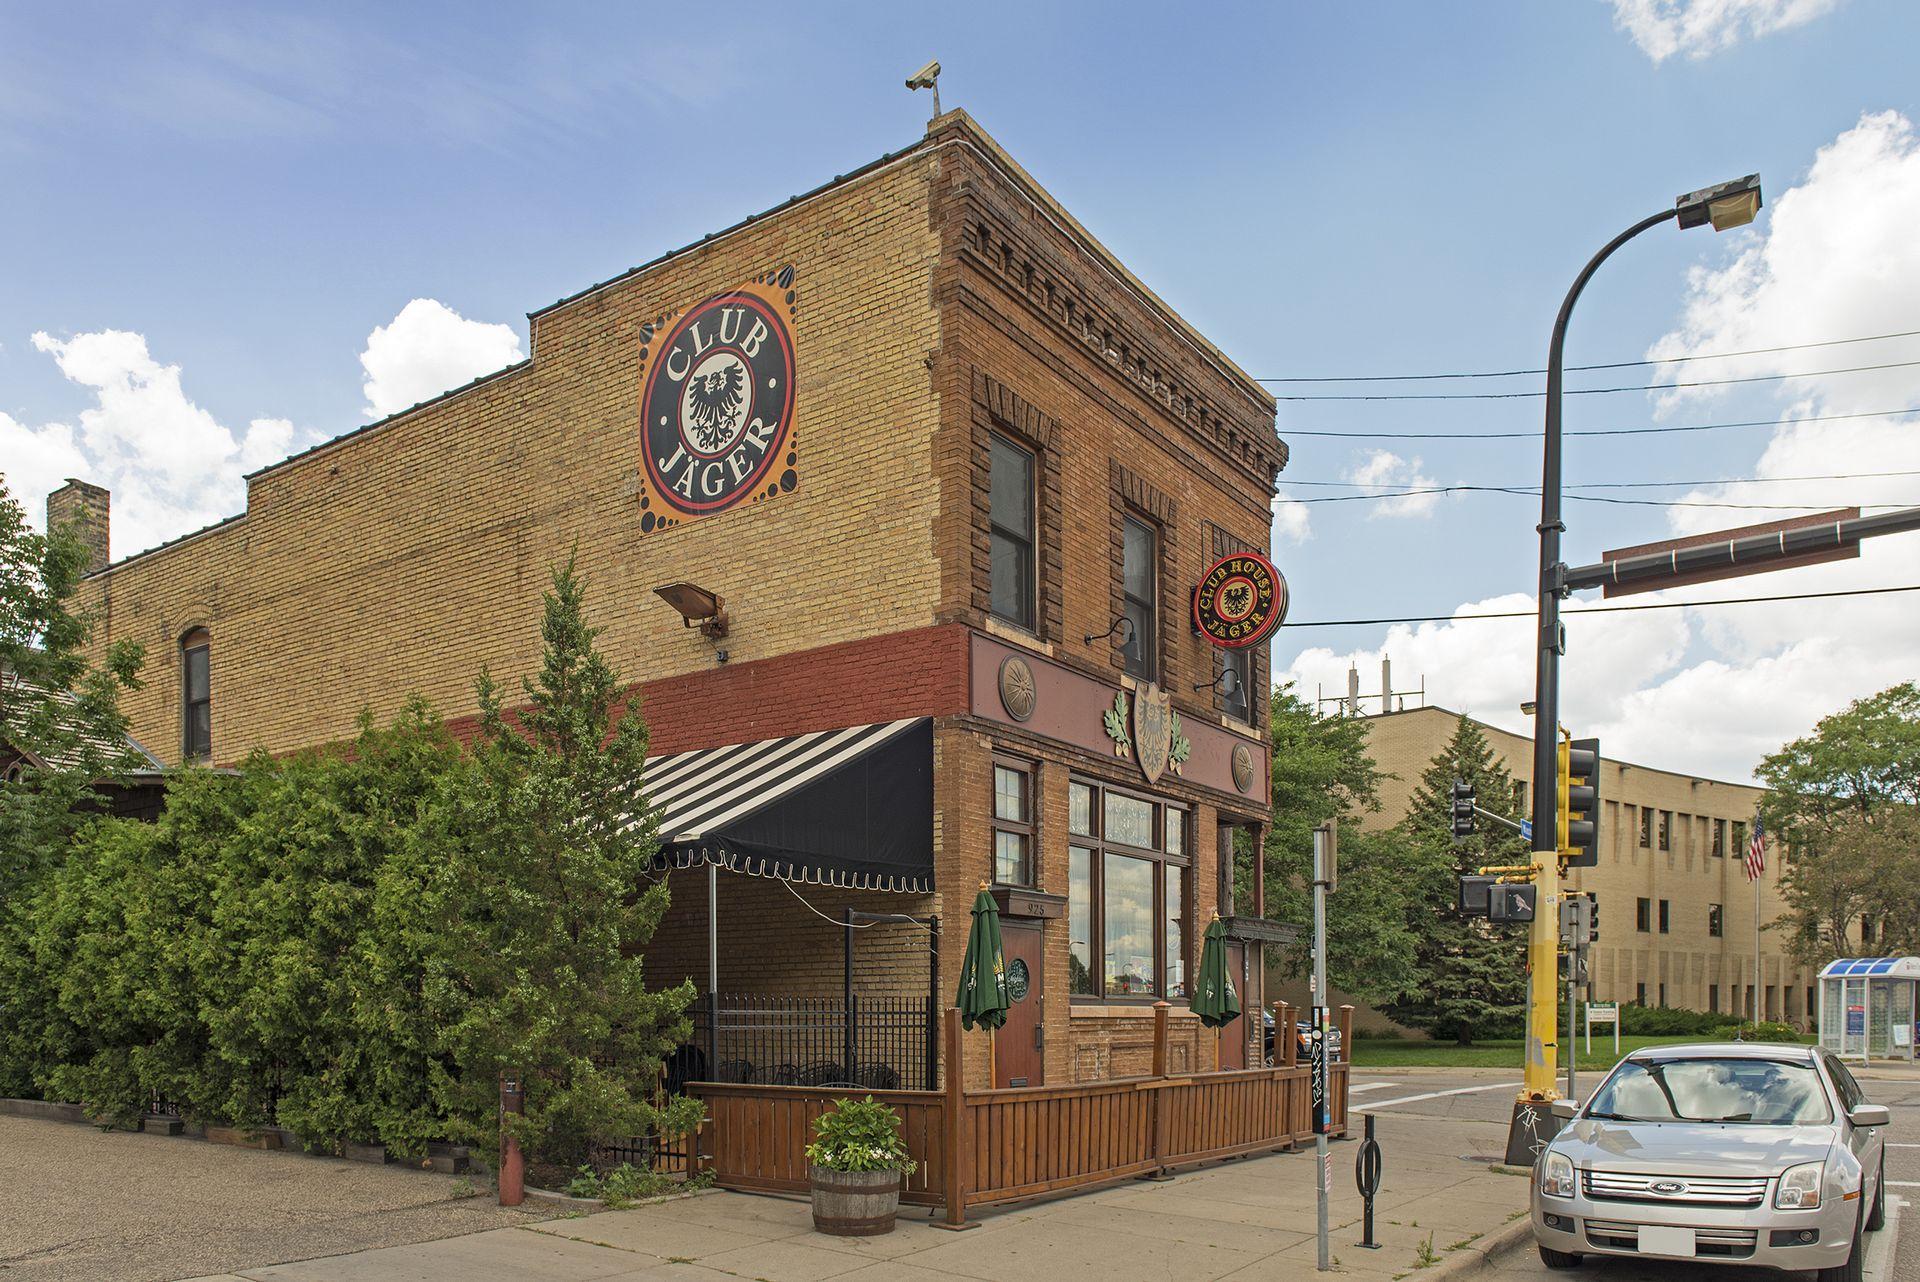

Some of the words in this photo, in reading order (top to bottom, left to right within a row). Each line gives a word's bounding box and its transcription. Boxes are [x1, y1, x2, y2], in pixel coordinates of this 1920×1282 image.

[666, 308, 768, 382] CLUB
[658, 416, 777, 499] JÄGER
[1200, 567, 1228, 610] CLUB
[1230, 560, 1271, 599] HOUSE
[1207, 612, 1264, 638] JÄGER
[1656, 1183, 1678, 1191] Ford
